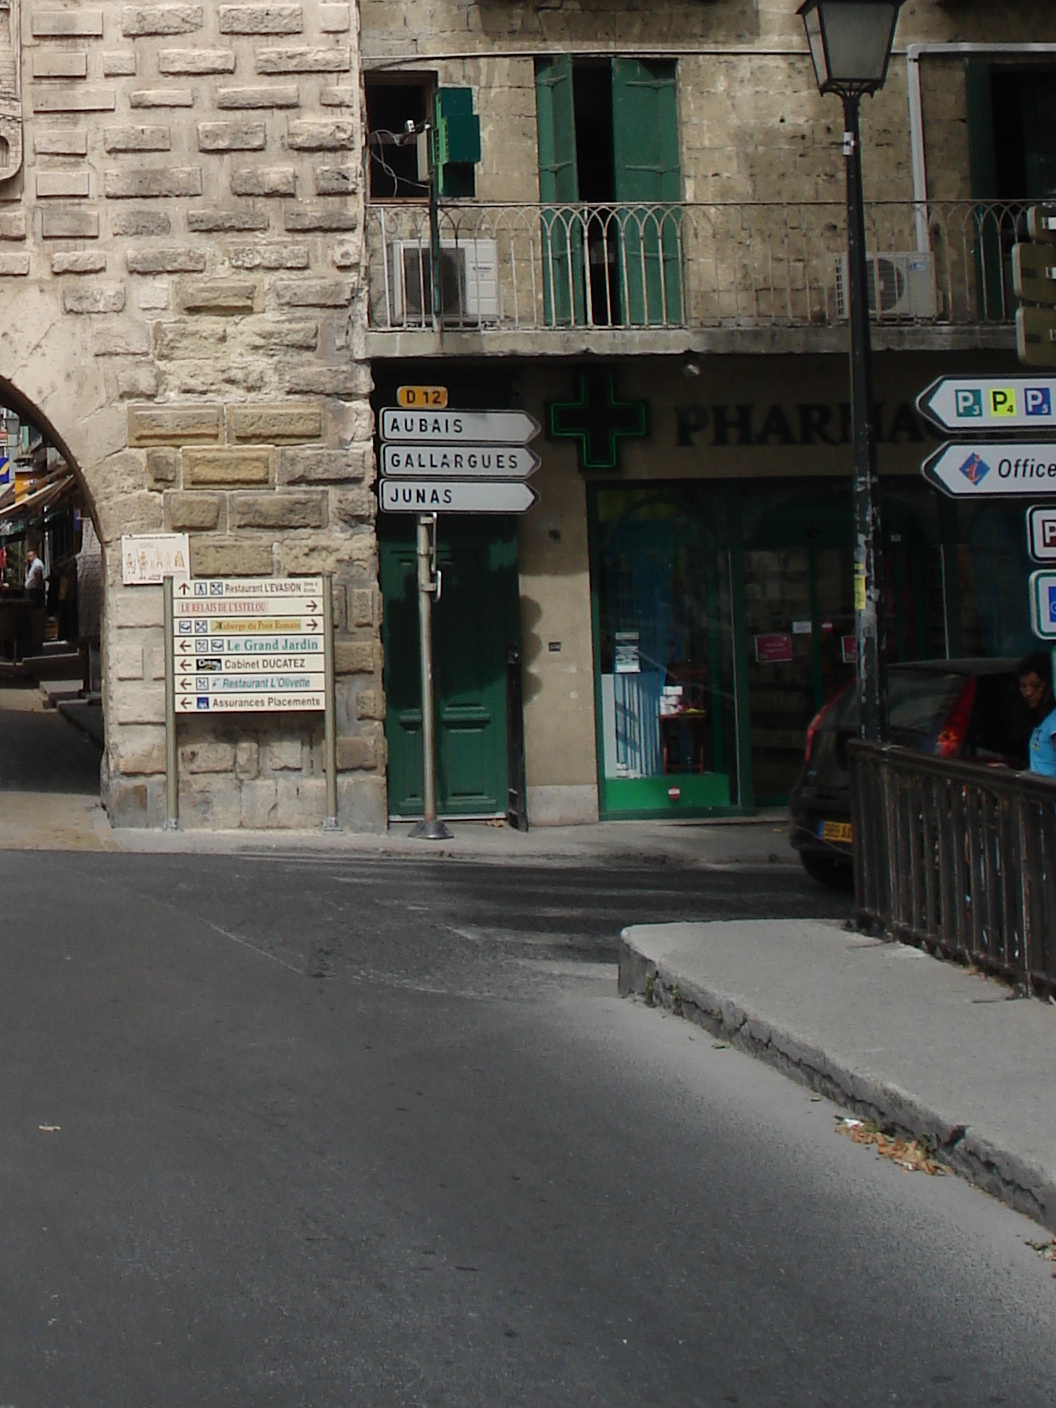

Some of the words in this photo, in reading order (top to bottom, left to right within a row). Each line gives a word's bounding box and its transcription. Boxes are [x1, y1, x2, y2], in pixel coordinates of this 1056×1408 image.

[406, 390, 416, 404] D
[423, 391, 441, 404] 12
[390, 418, 463, 433] AUBAIS
[675, 403, 1014, 446] PHARA
[391, 454, 518, 469] GALLARGUES
[998, 458, 1056, 478] Office
[390, 488, 452, 504] JUNAS
[225, 584, 263, 593] Restaurant
[264, 582, 301, 593] L'EVASION
[192, 603, 217, 612] RELAIS
[218, 603, 227, 612] DE
[227, 639, 241, 652] Le
[244, 639, 279, 651] Grand
[282, 638, 319, 650] Jardin
[224, 659, 260, 669] Cabinet
[262, 658, 306, 669] DUCATEZ
[223, 678, 269, 689] Restaurant
[270, 677, 311, 688] L'Olivette
[212, 698, 265, 708] Assurances
[268, 697, 321, 707] Placements
